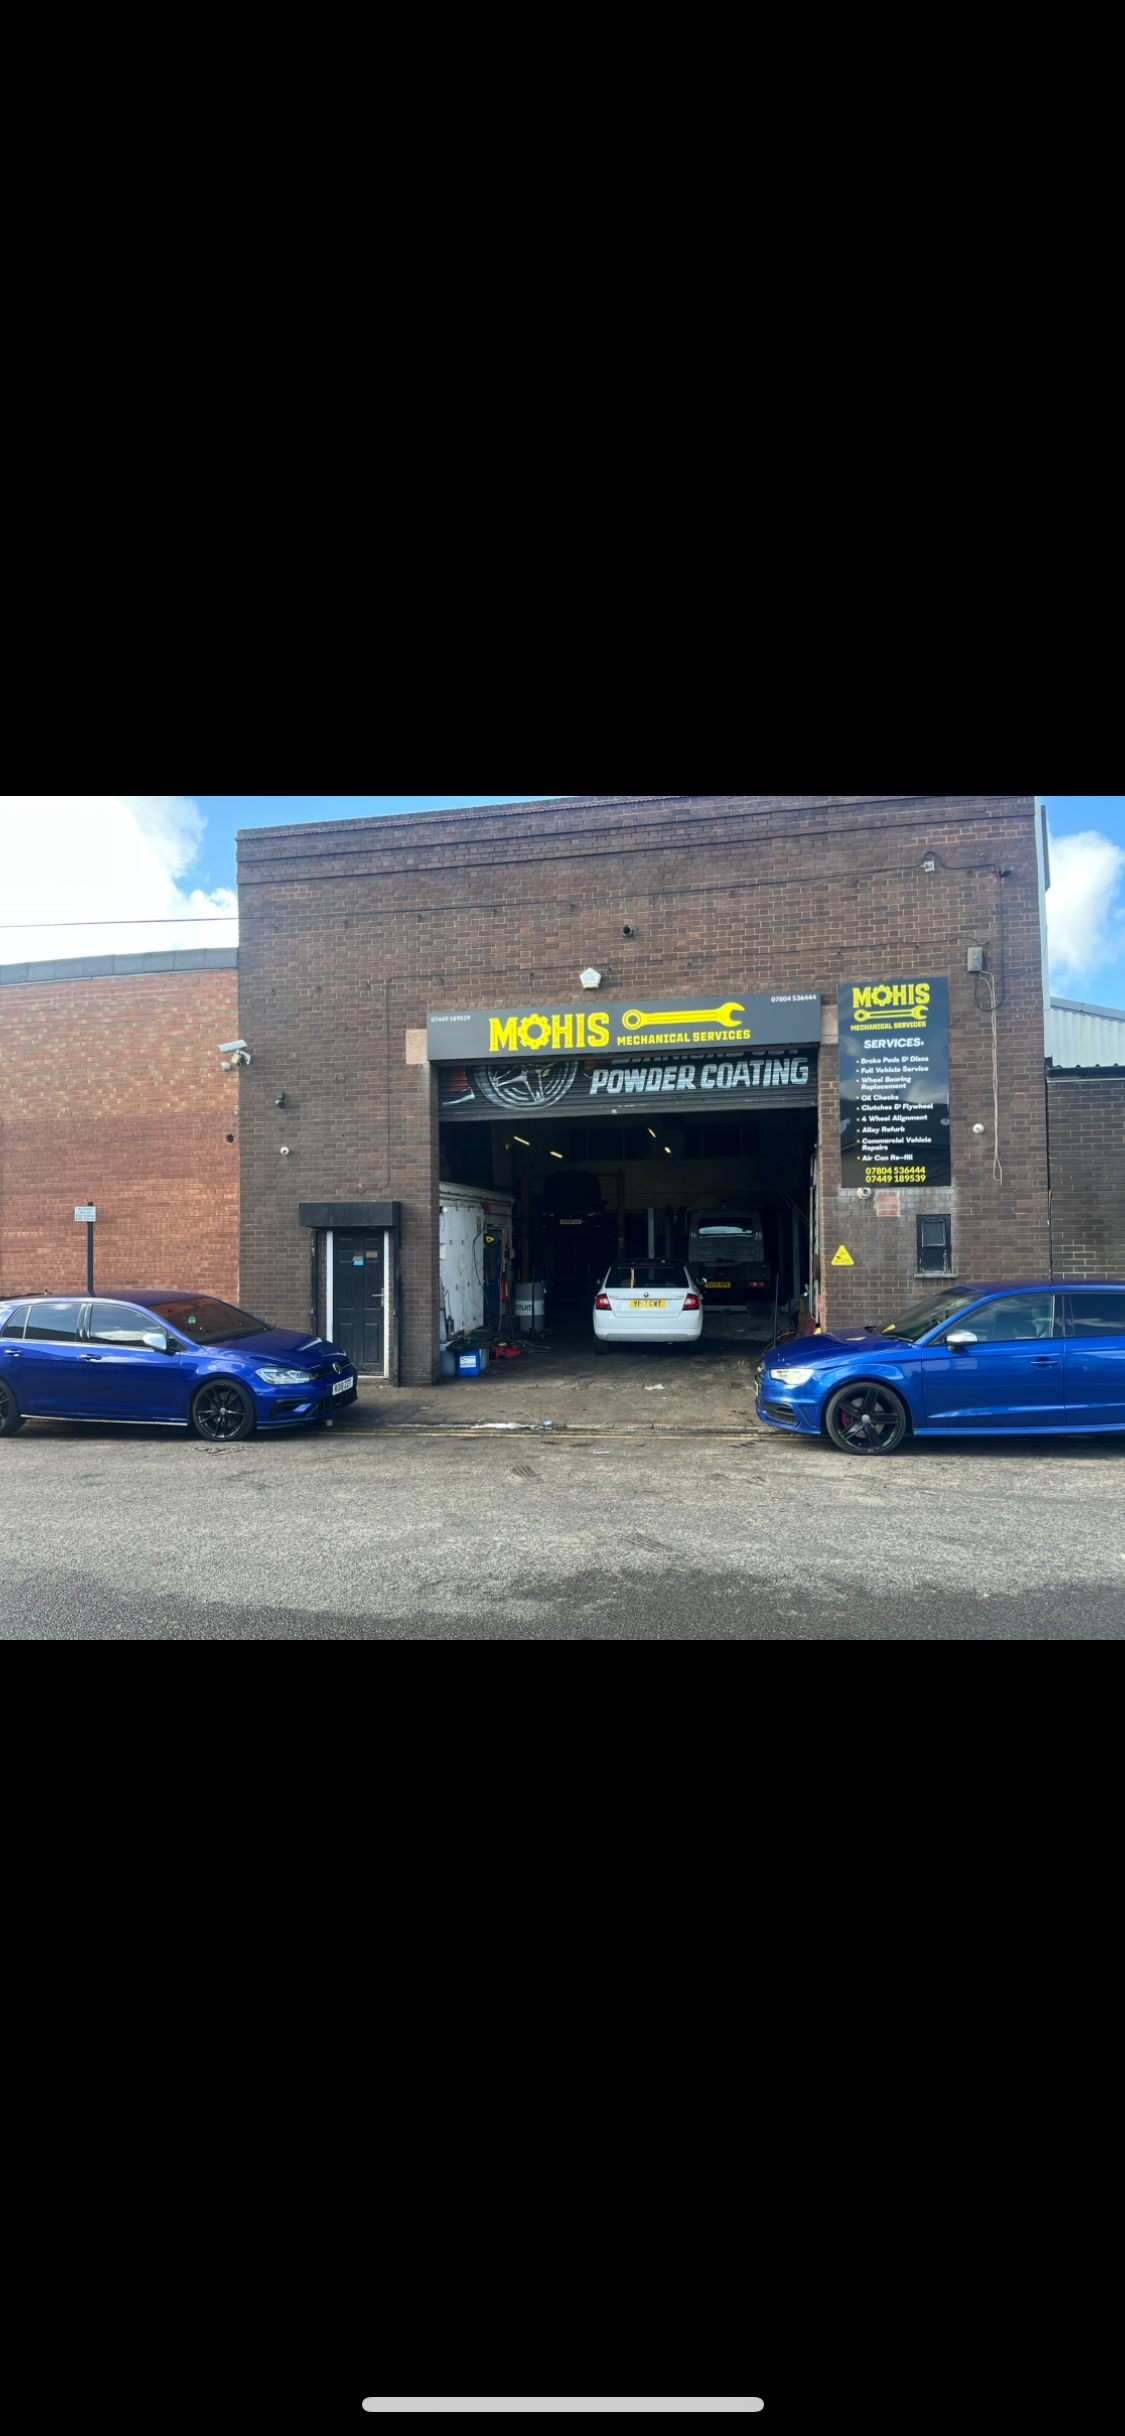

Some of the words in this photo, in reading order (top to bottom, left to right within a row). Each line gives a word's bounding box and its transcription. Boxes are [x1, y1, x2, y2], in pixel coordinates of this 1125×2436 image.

[852, 983, 930, 1008] MOHIS
[850, 1023, 893, 1031] MECHANICAL
[894, 1021, 927, 1029] SERVICES
[489, 1012, 610, 1052] MOHIS
[617, 1033, 690, 1046] MECHANICAL
[693, 1029, 751, 1042] SERVICES
[589, 1064, 696, 1095] POWDER
[700, 1057, 809, 1089] COATING
[861, 1083, 907, 1091] Replacement
[902, 1103, 934, 1111] Flywheel
[892, 1114, 928, 1122] Alignment
[862, 1126, 880, 1134] Alloy
[861, 1144, 888, 1152] Repairs
[865, 1166, 892, 1175] 07804
[893, 1166, 926, 1175] 536444
[865, 1175, 892, 1183] 07449
[894, 1174, 926, 1183] 189539
